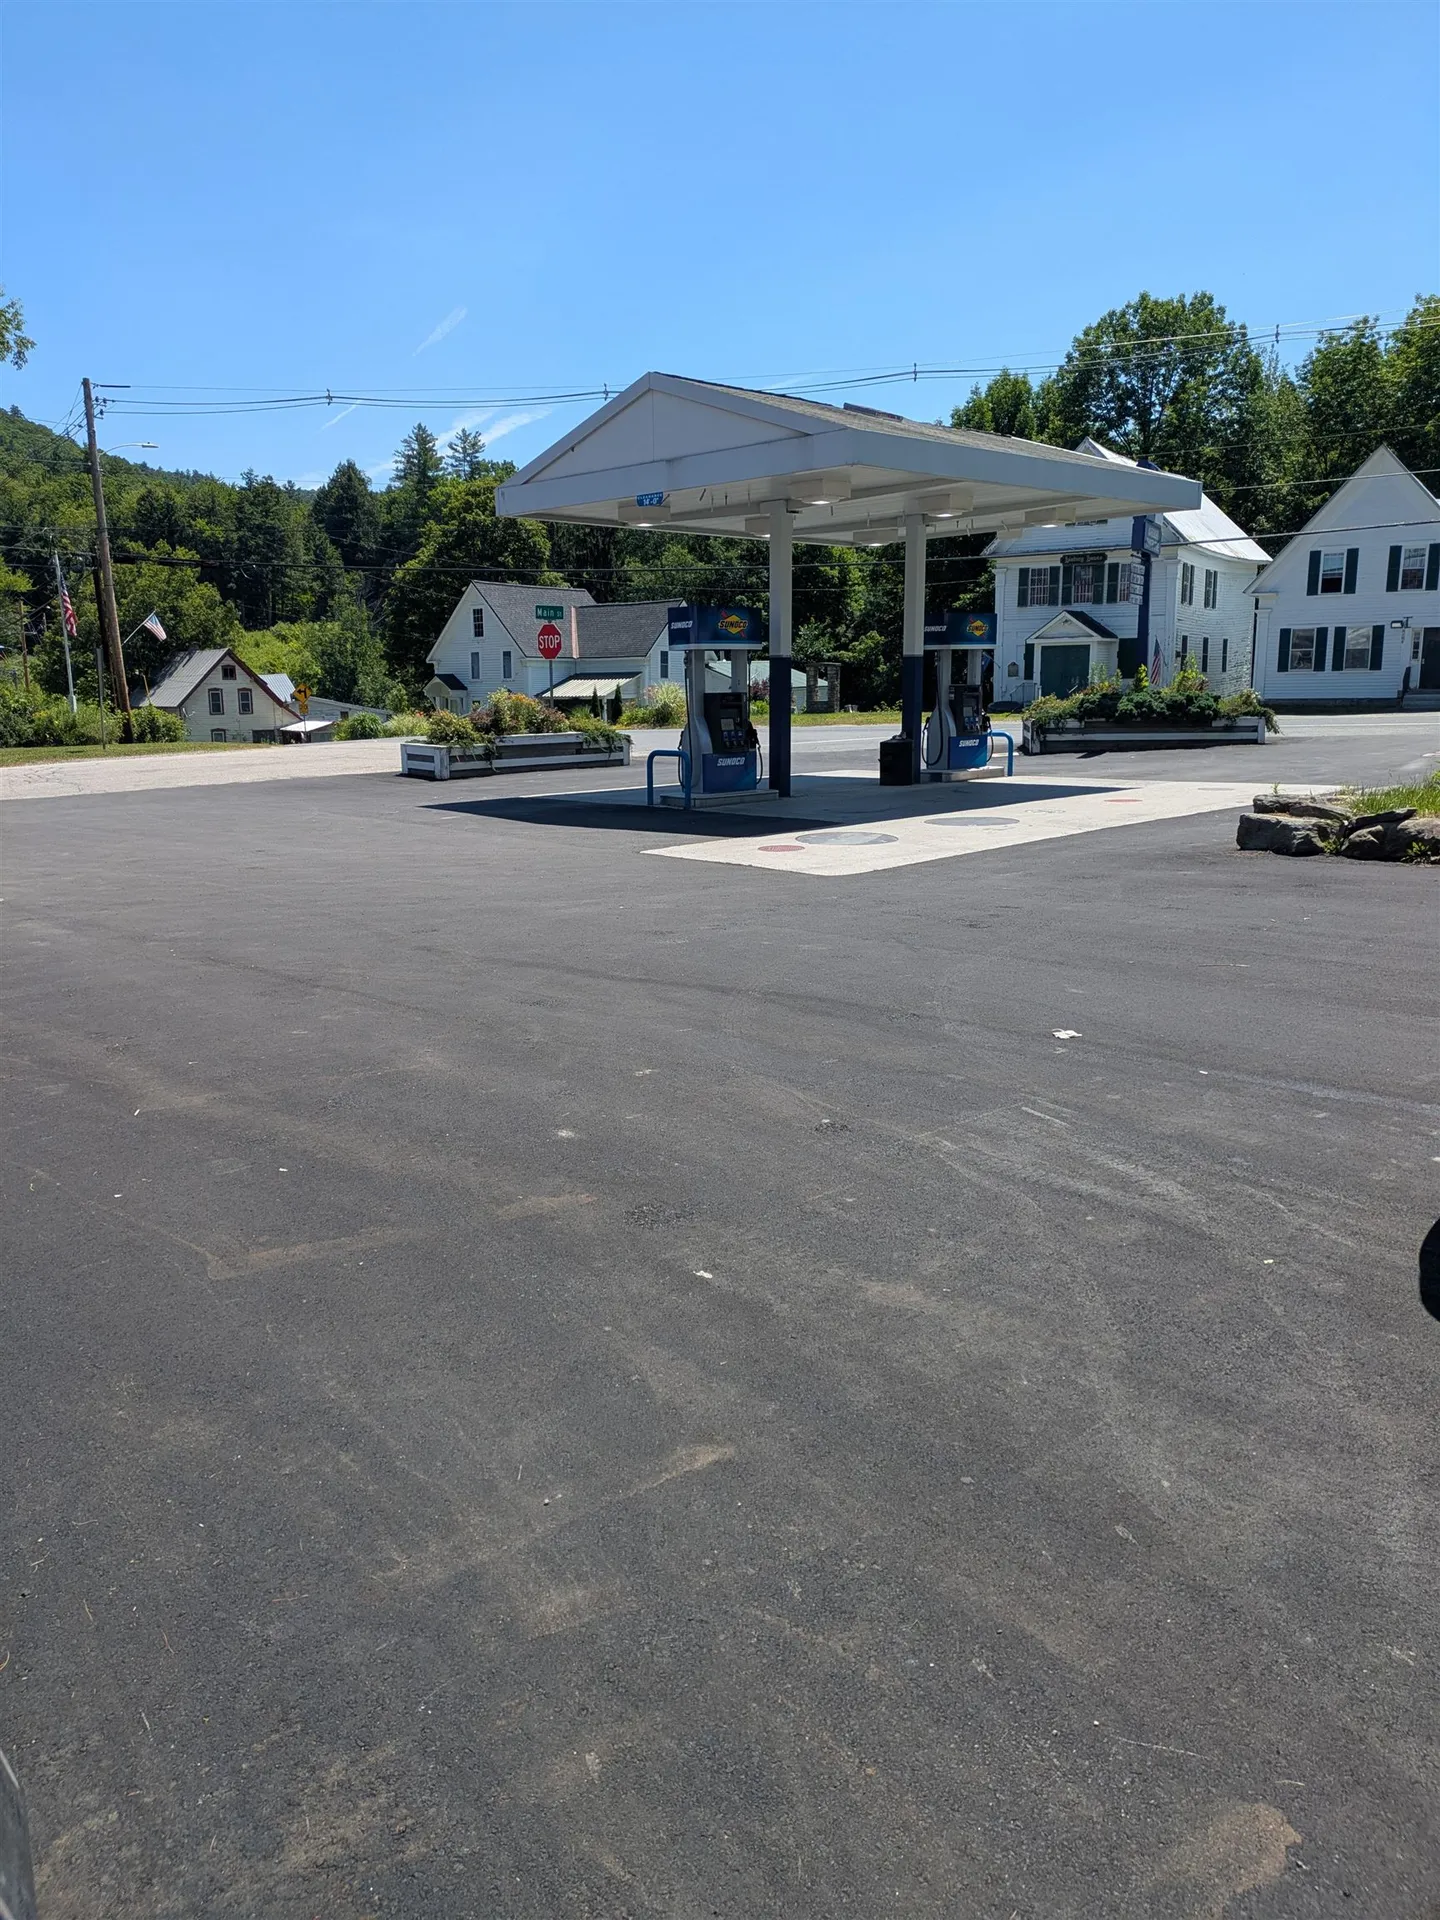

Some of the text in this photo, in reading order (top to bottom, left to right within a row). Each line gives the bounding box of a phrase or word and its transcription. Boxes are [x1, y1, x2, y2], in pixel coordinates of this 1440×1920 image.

[537, 608, 554, 617] Main
[671, 621, 693, 629] SUNOCO
[719, 620, 748, 629] SUNOCO
[539, 635, 560, 649] STOP
[959, 739, 980, 747] SUNOCO
[717, 757, 745, 767] SUNOCO
